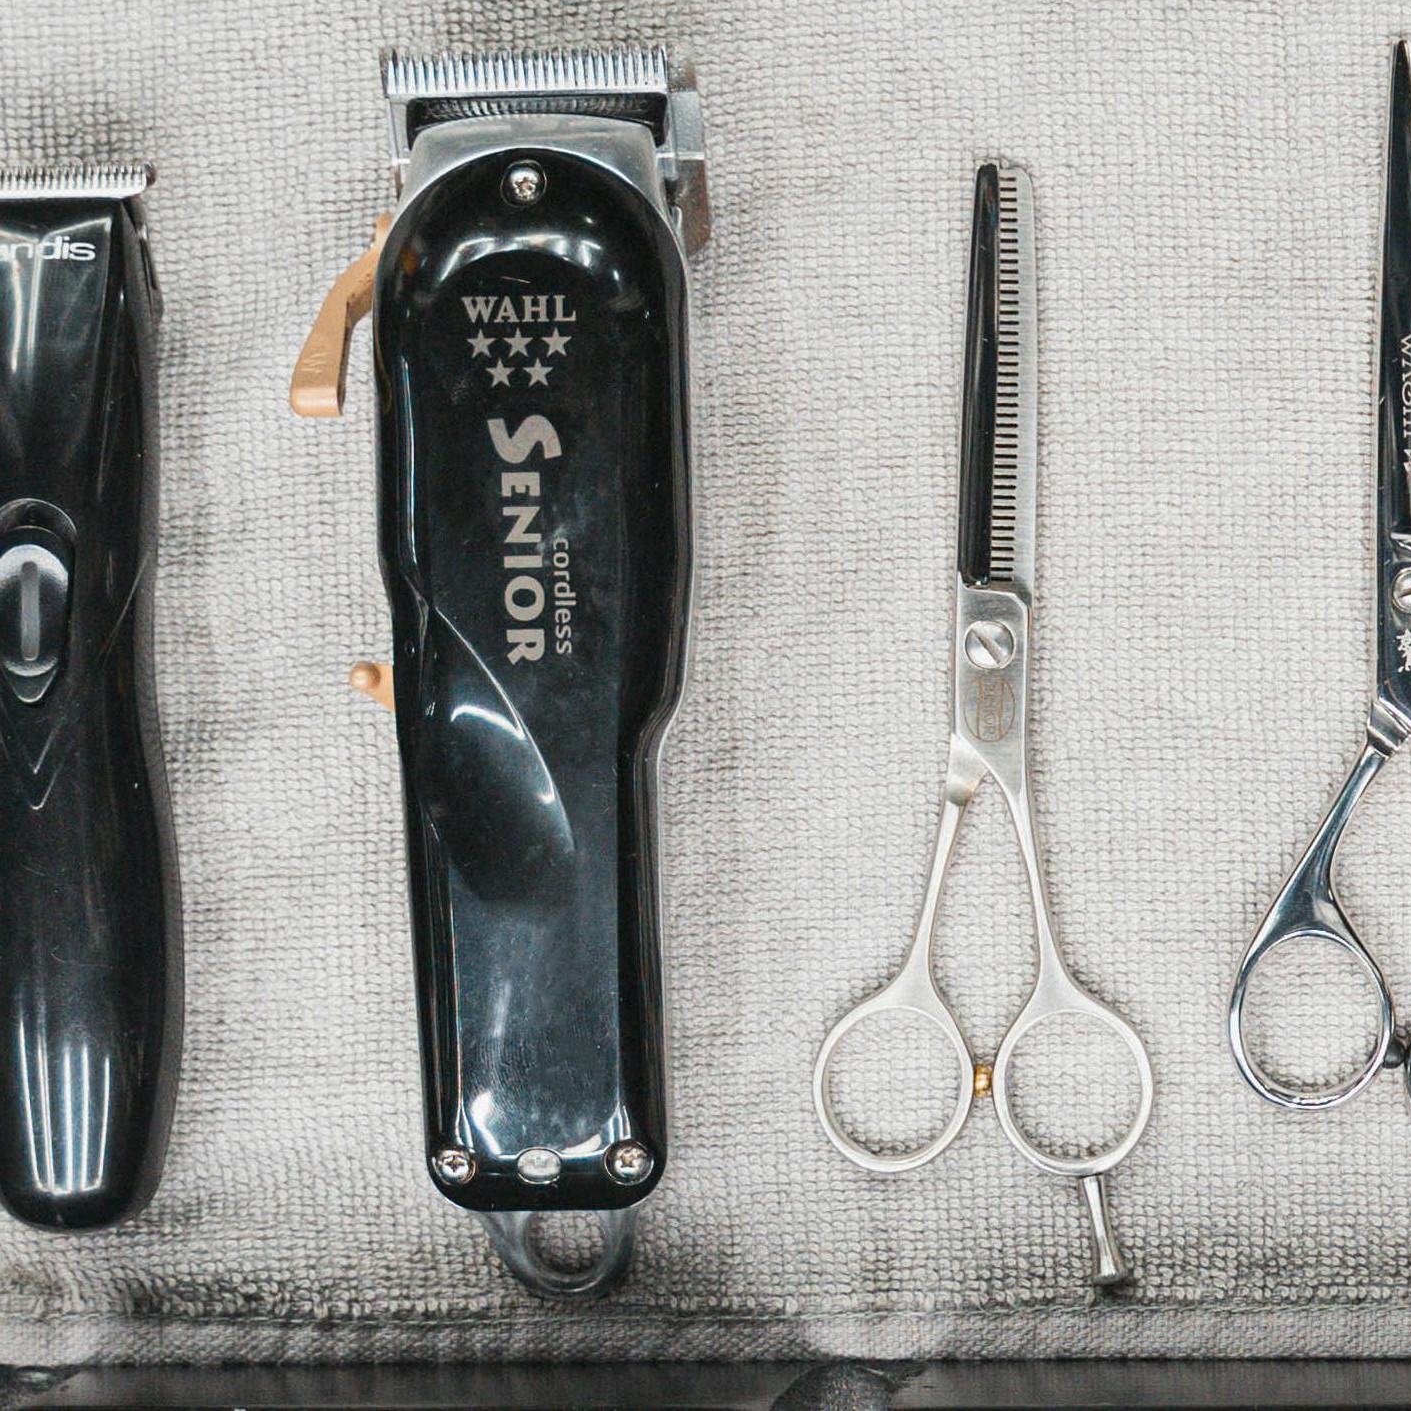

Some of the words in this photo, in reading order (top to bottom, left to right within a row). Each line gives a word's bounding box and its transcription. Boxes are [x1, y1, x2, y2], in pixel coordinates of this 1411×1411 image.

[462, 295, 577, 323] WAHL
[487, 414, 563, 665] SENIOR
[553, 537, 577, 655] cordless
